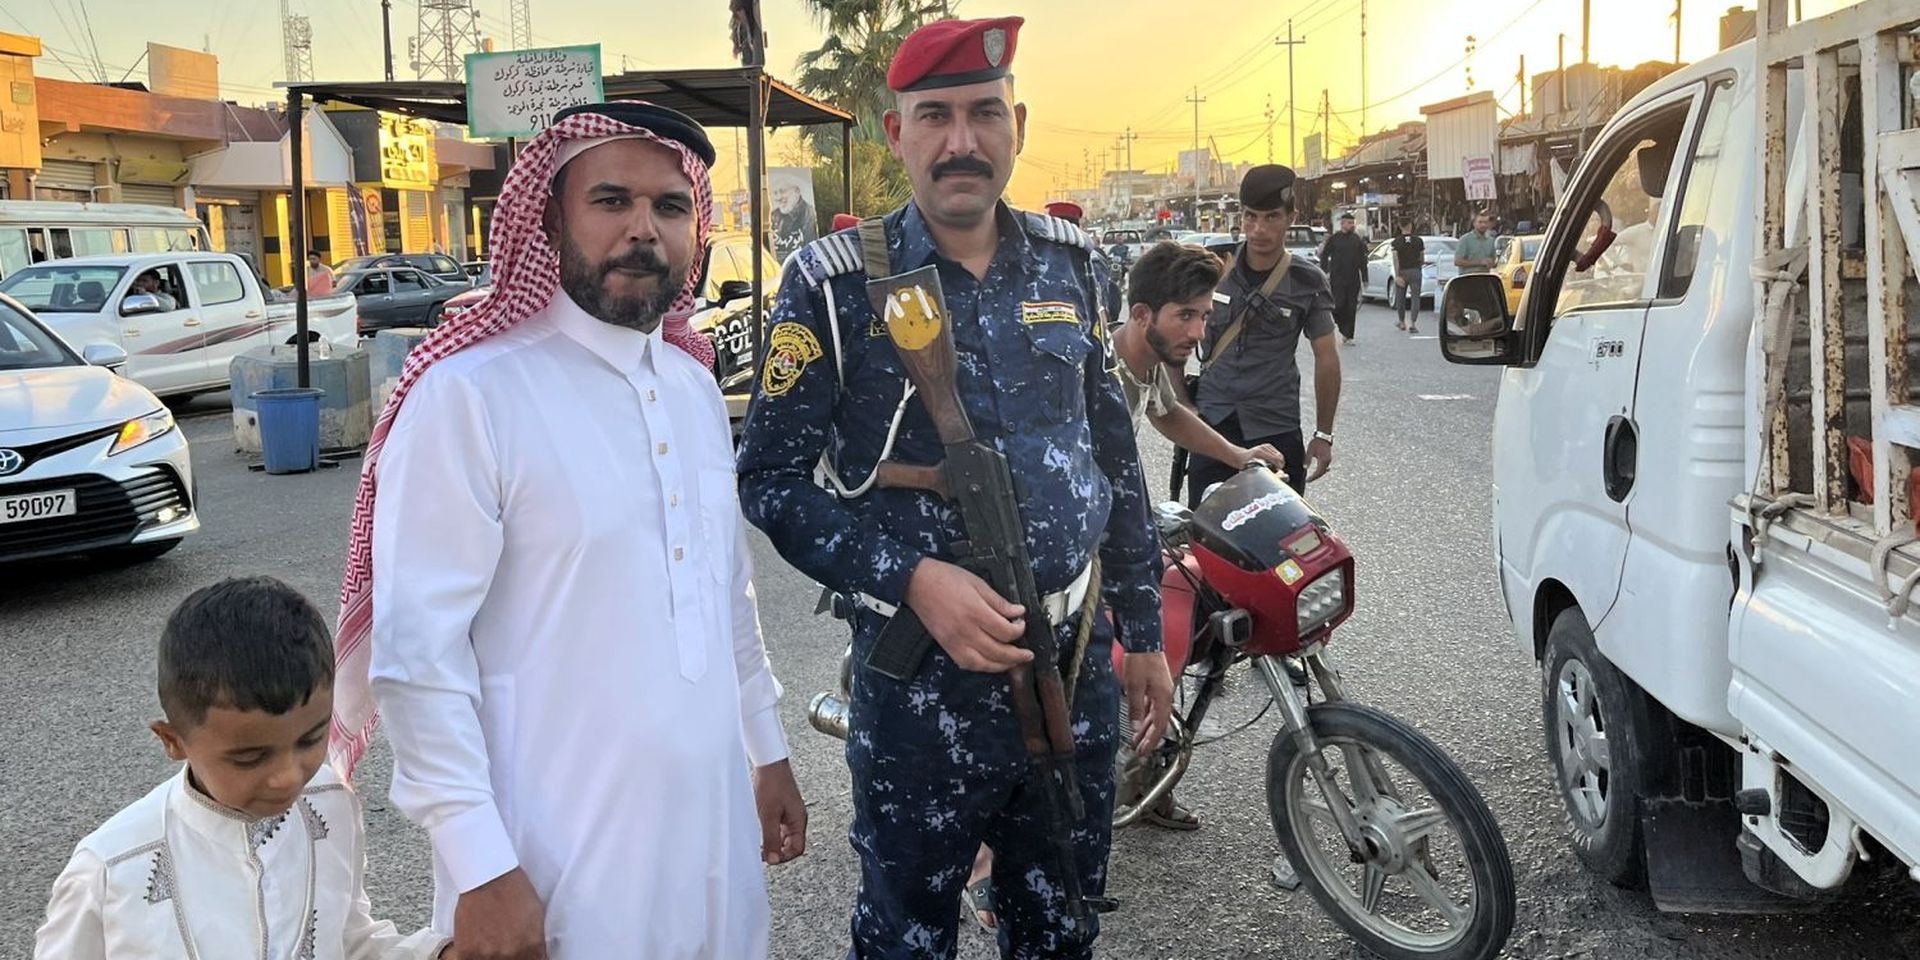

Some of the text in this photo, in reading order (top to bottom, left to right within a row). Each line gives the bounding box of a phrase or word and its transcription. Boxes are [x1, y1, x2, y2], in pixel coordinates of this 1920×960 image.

[517, 51, 567, 66] وزارة الداخلية
[494, 61, 594, 81] قيادة شرطة محافظة كركوك
[503, 77, 584, 97] قسم شرطة نجدة كركوك
[531, 97, 545, 111] نجدة
[549, 96, 567, 110] شرطة
[530, 113, 553, 131] 911
[6, 495, 66, 519] 59097
